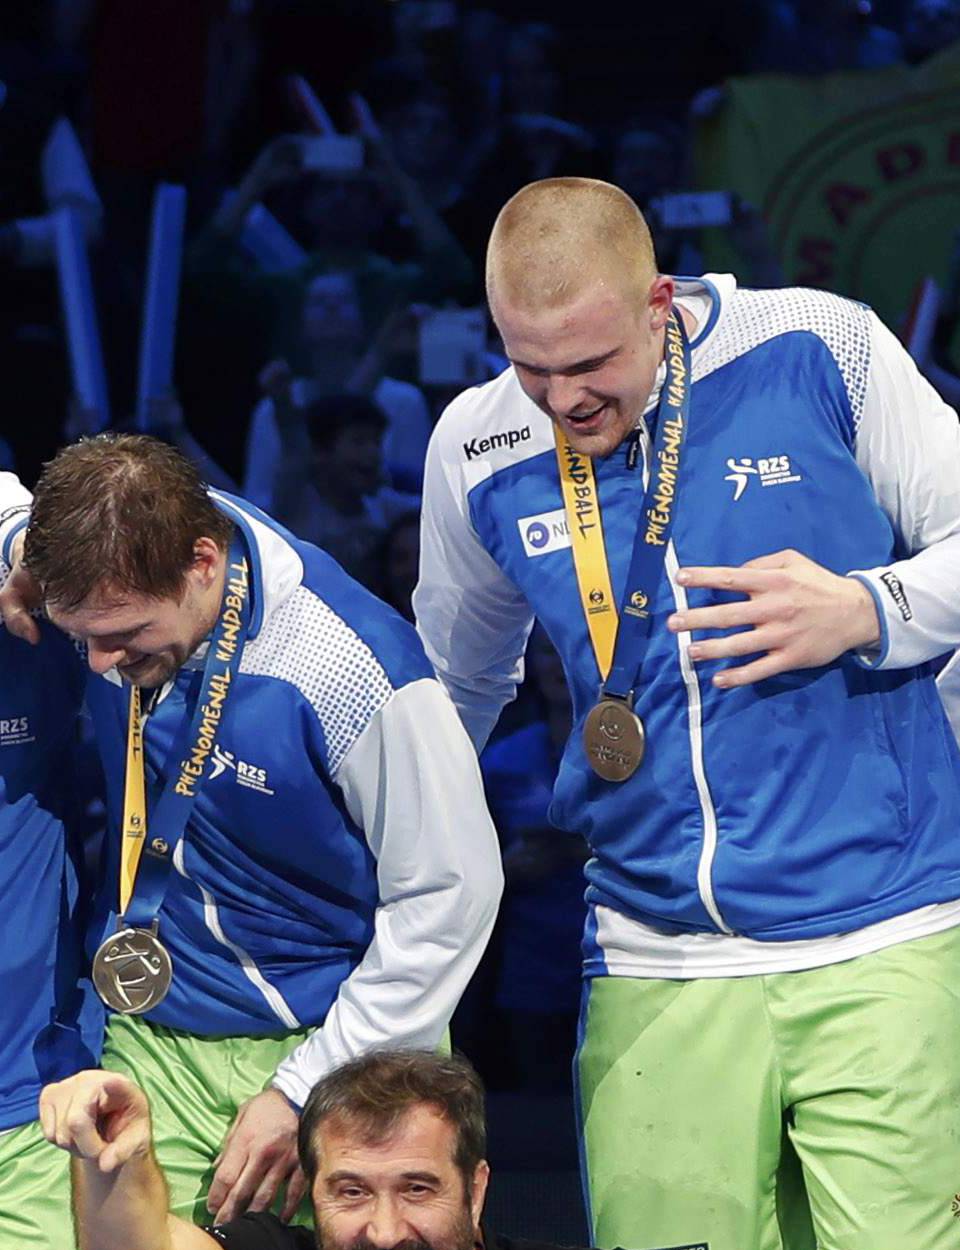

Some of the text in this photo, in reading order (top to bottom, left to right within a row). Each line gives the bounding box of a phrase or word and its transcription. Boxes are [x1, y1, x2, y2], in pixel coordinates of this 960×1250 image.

[463, 426, 532, 460] Kempa
[758, 456, 790, 475] RZS
[553, 520, 570, 537] NL
[214, 556, 250, 663] HANDBALL
[0, 716, 28, 734] RZS
[237, 760, 267, 782] RZS
